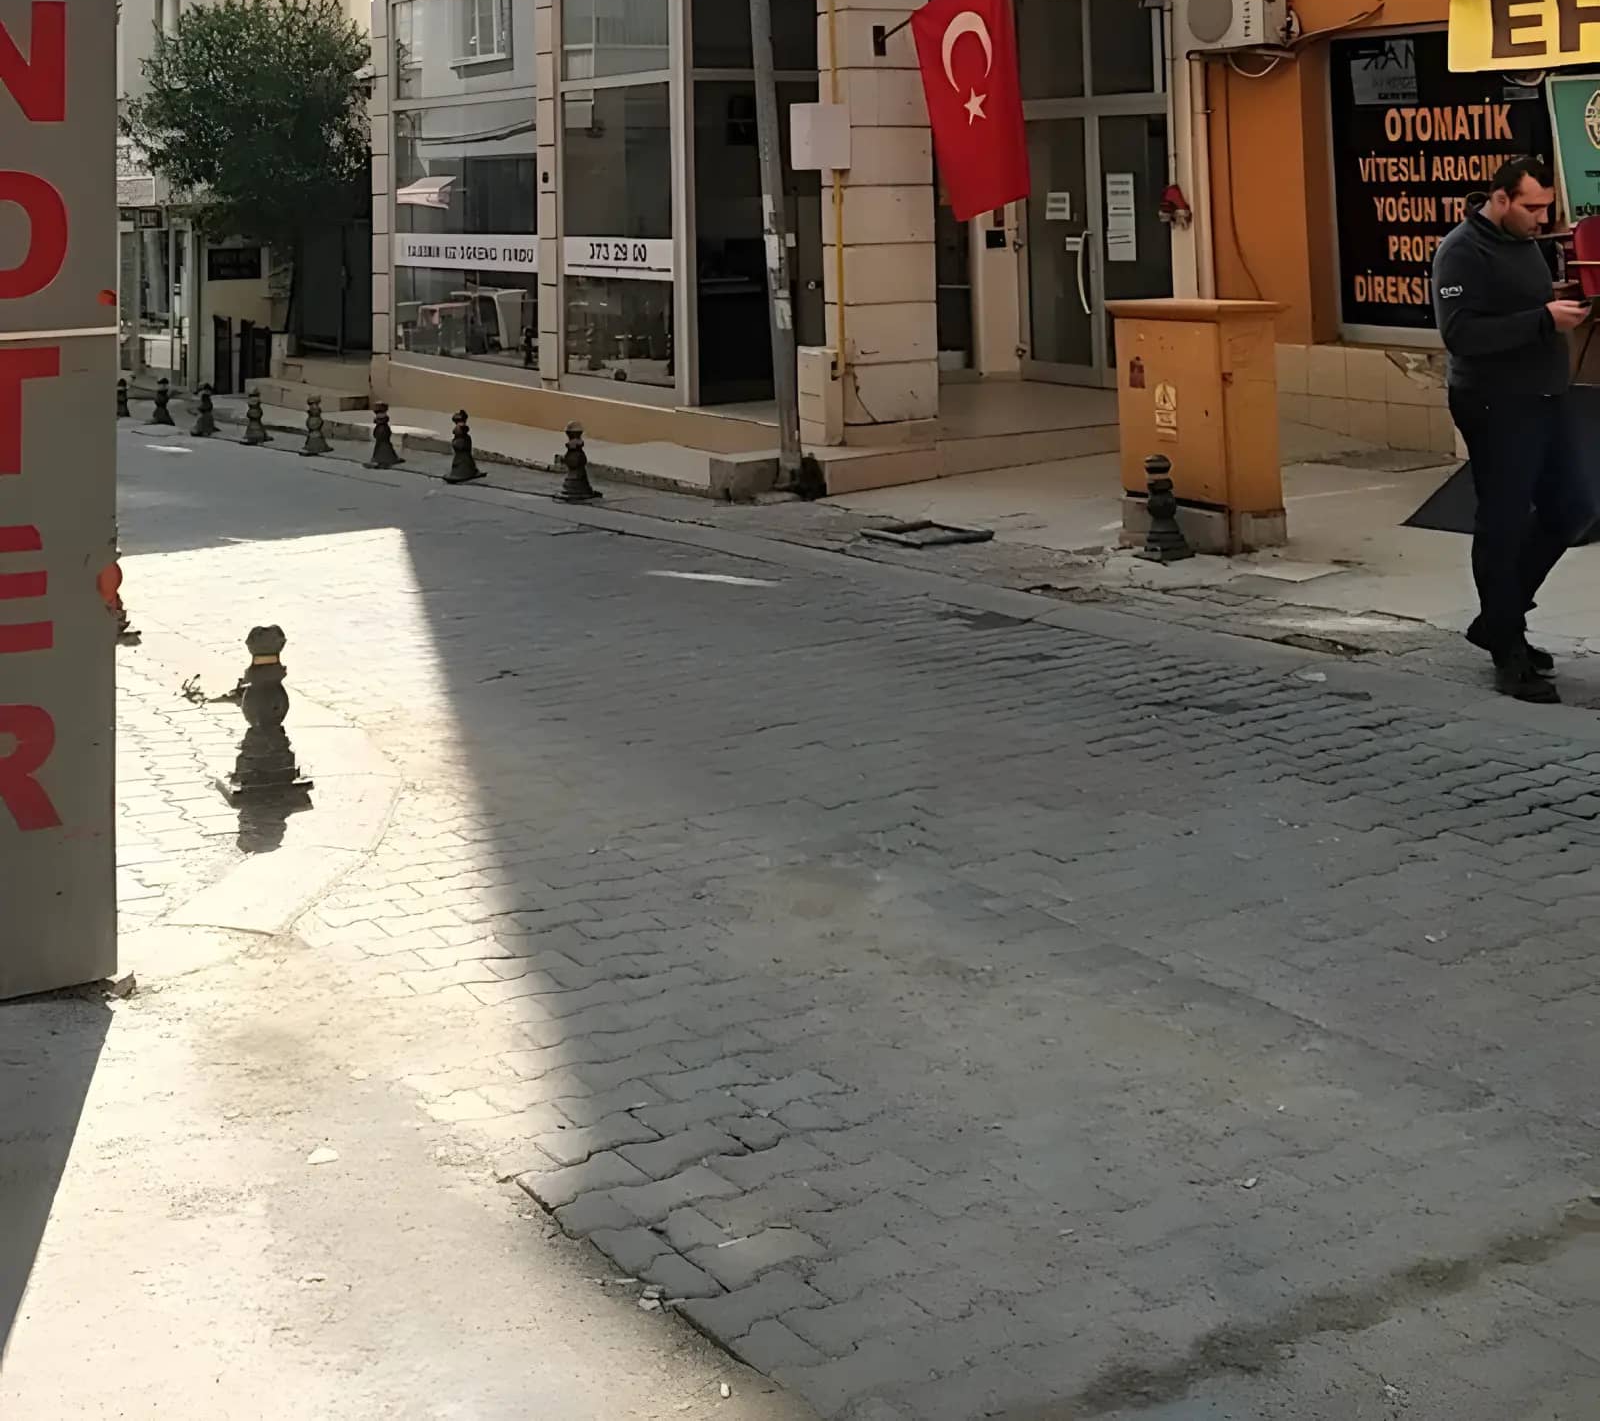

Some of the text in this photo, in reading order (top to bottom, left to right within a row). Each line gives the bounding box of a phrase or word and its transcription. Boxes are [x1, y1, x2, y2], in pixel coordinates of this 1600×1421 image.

[1384, 97, 1513, 142] OTOMATİK
[1359, 151, 1427, 182] VİTESLİ
[1373, 191, 1466, 223] YOĞUN TR
[1388, 235, 1442, 262] PROF
[1354, 269, 1432, 305] DİREKSİ
